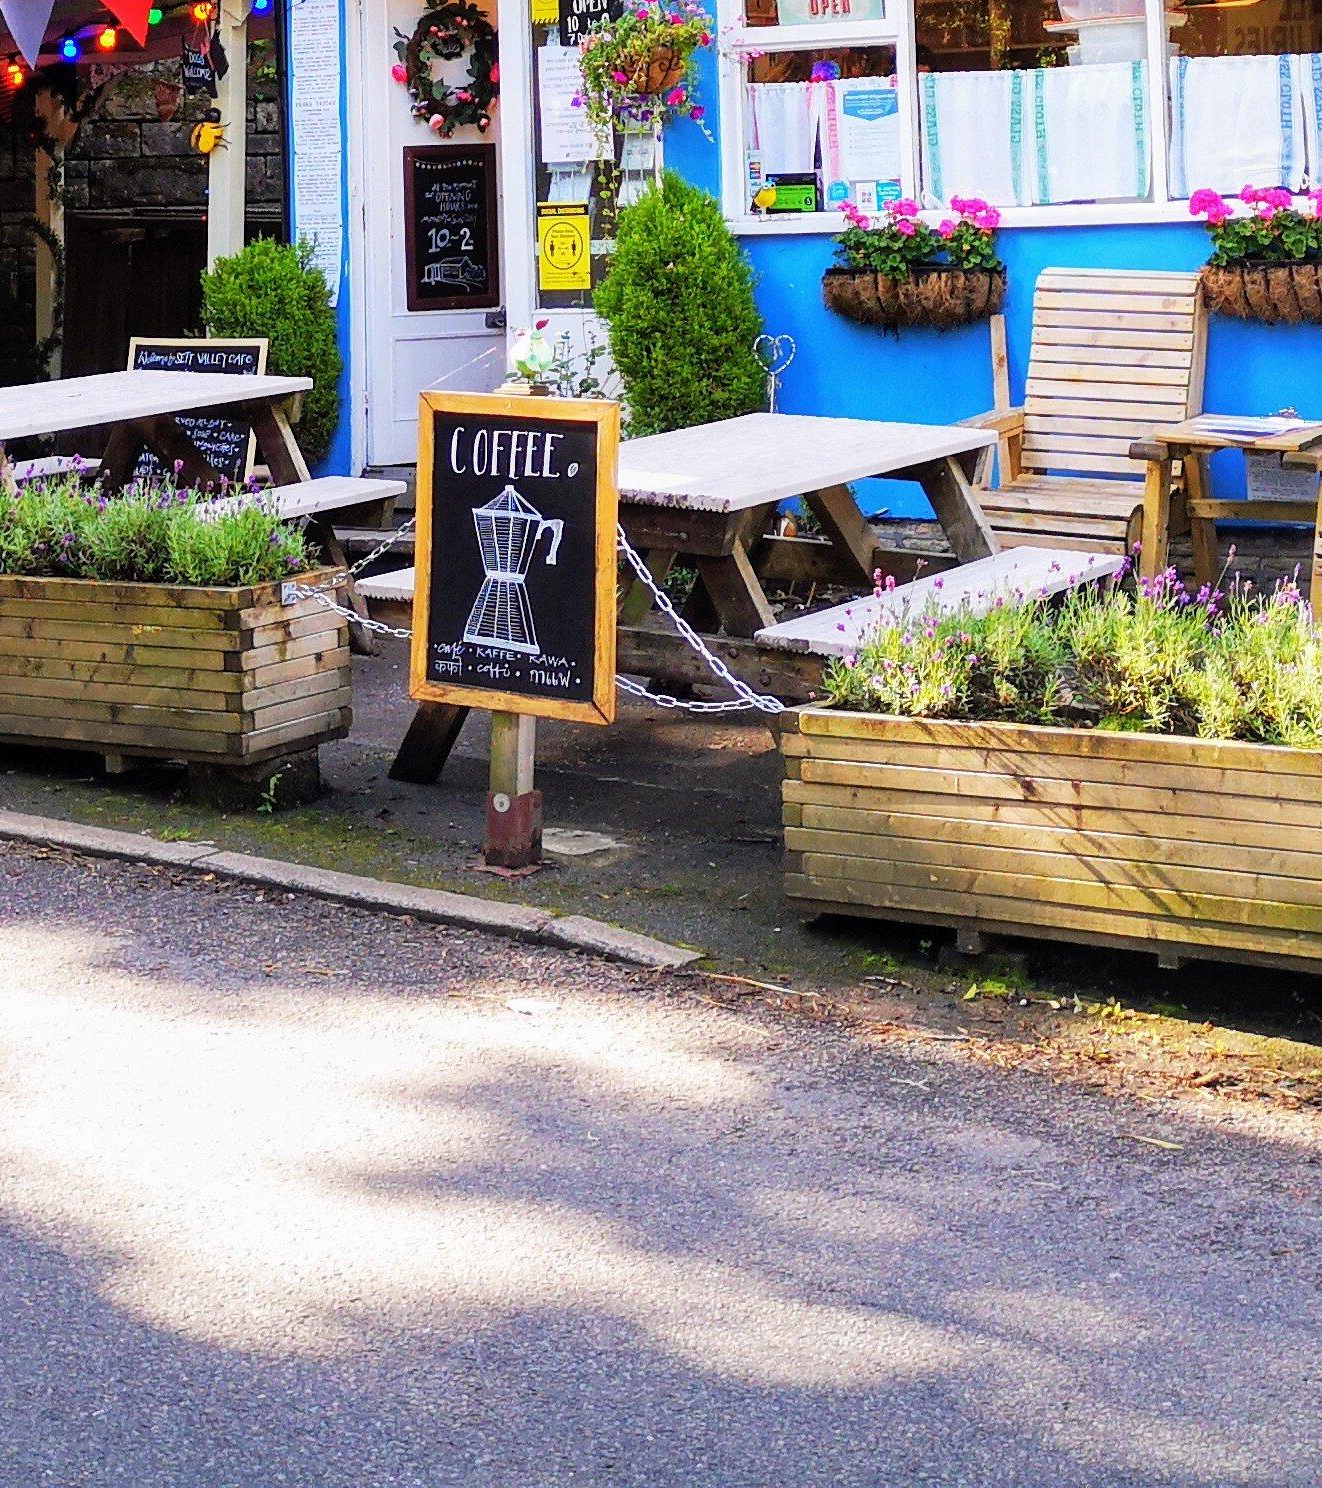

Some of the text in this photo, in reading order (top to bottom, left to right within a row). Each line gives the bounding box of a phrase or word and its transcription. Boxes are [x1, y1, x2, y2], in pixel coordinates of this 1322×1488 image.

[566, 15, 579, 33] 10
[175, 351, 196, 366] SETT
[197, 352, 226, 368] VALLEY
[450, 426, 564, 480] COFFEE
[475, 647, 516, 661] KAFFE
[528, 654, 569, 667] KAWA
